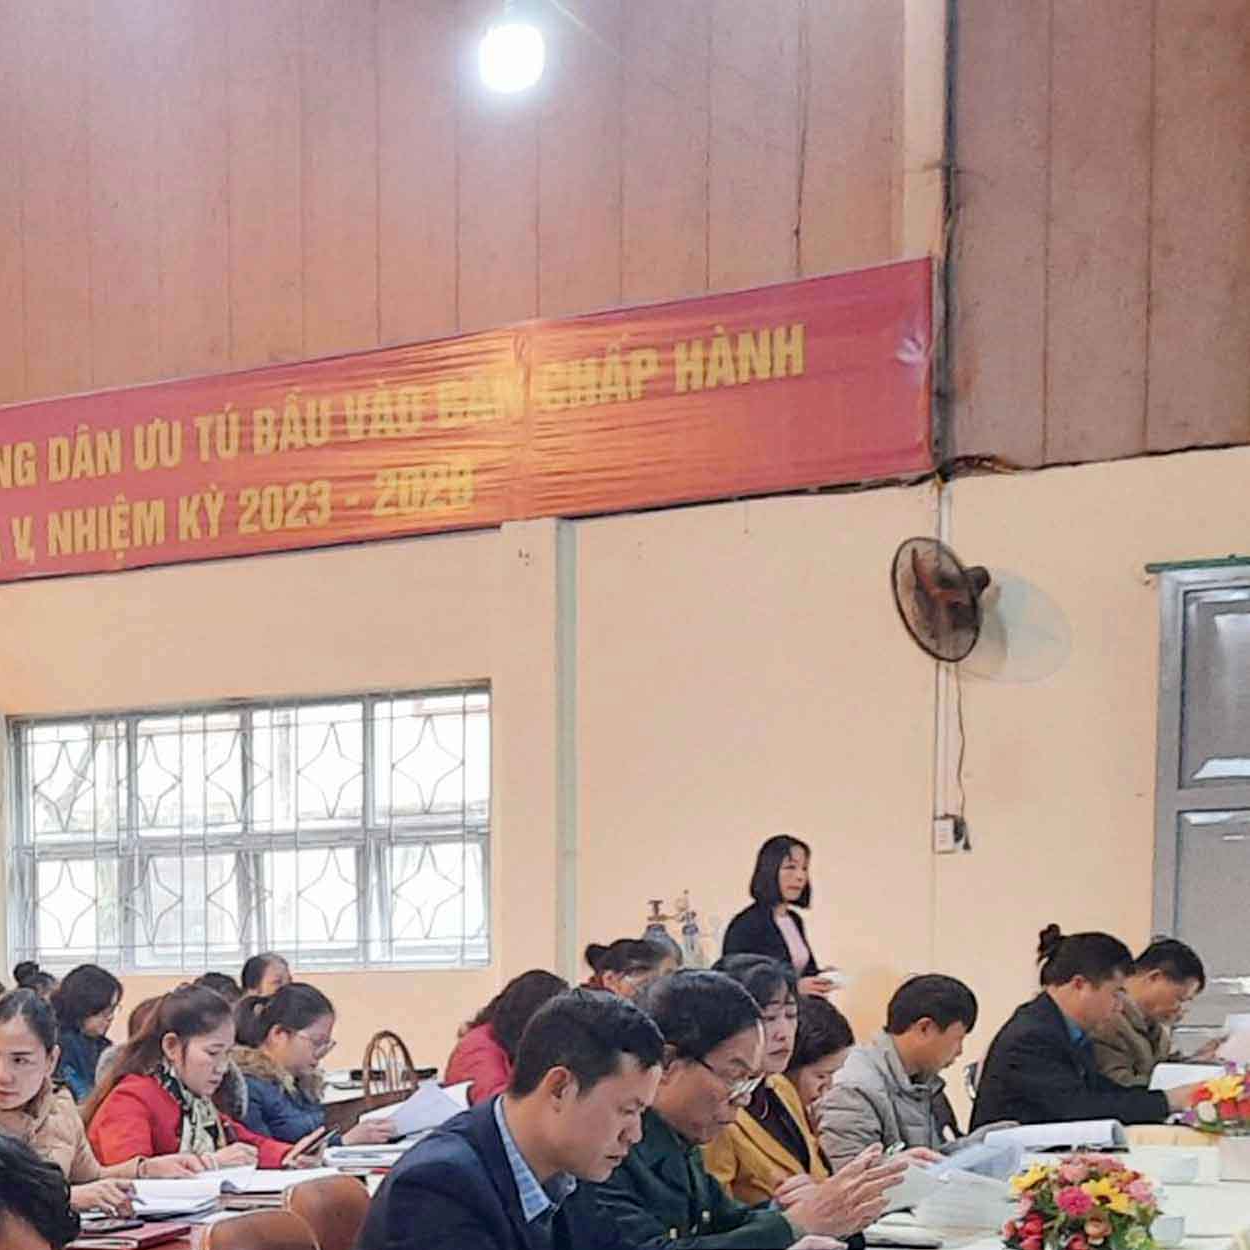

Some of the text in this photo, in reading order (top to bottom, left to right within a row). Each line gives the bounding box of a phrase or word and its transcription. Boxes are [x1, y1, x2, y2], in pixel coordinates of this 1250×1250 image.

[48, 424, 122, 481] DÂN
[133, 417, 182, 471] ƯU
[194, 402, 240, 462] TÚ
[673, 323, 805, 393] HÀNH
[47, 491, 166, 560] NHIỆM
[177, 484, 225, 542] KỲ
[237, 479, 333, 535] 2023
